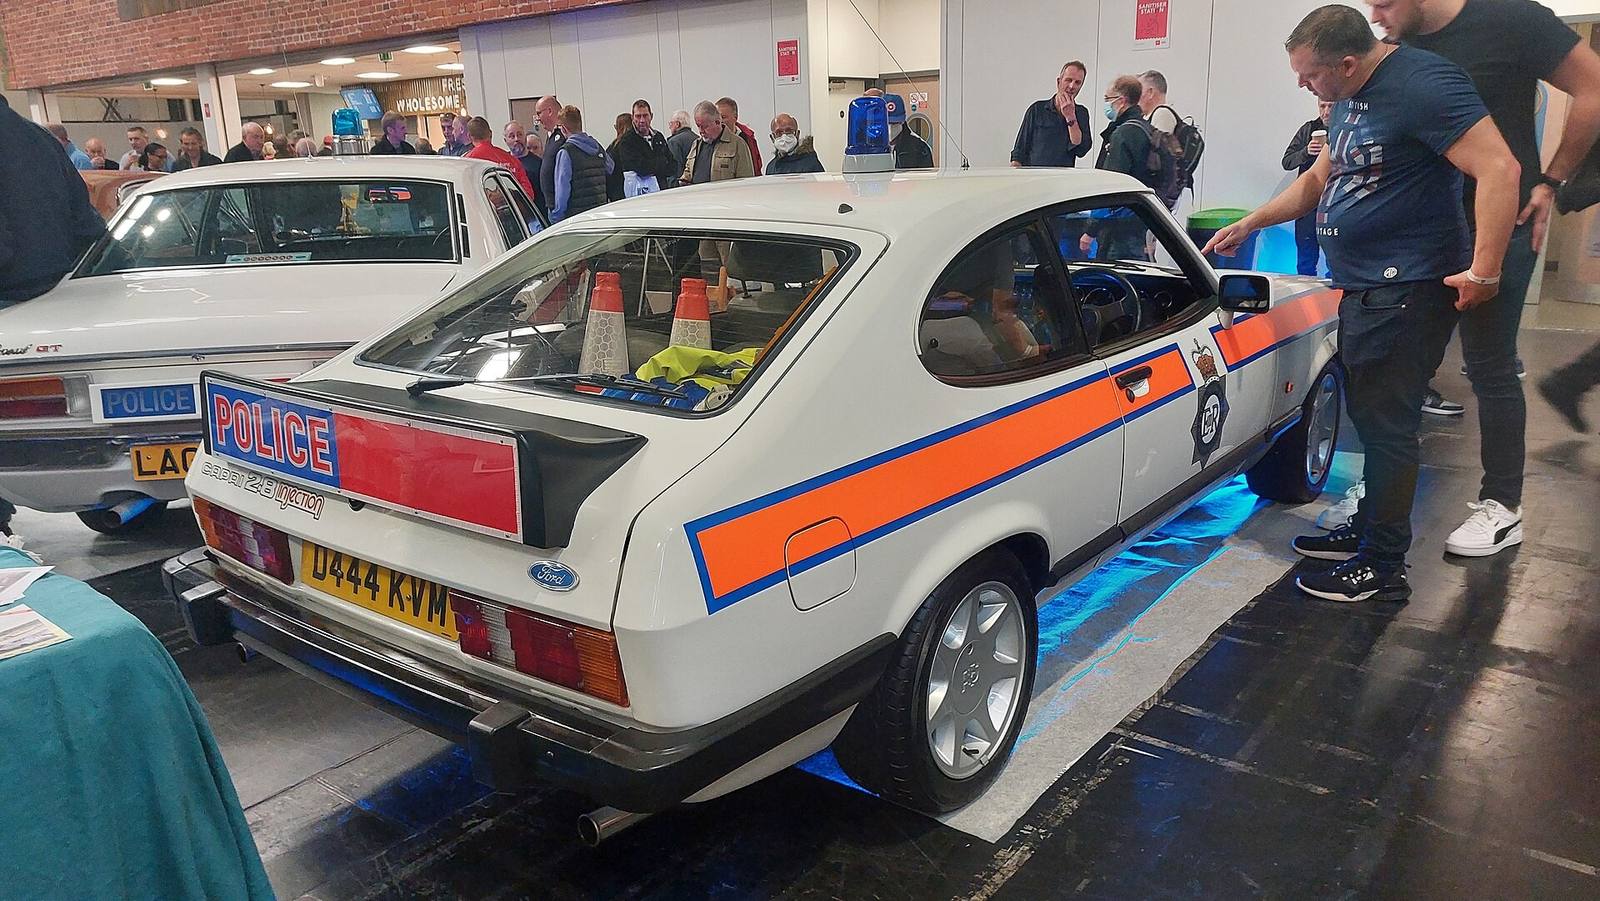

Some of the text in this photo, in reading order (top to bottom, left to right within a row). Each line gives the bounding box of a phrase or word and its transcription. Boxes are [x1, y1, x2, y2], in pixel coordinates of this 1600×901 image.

[36, 344, 63, 353] GT
[106, 388, 192, 414] POLICE
[213, 393, 334, 476] POLICE
[201, 461, 245, 488] CAPRI
[312, 544, 448, 627] D444 KVM
[537, 565, 566, 585] Ford
